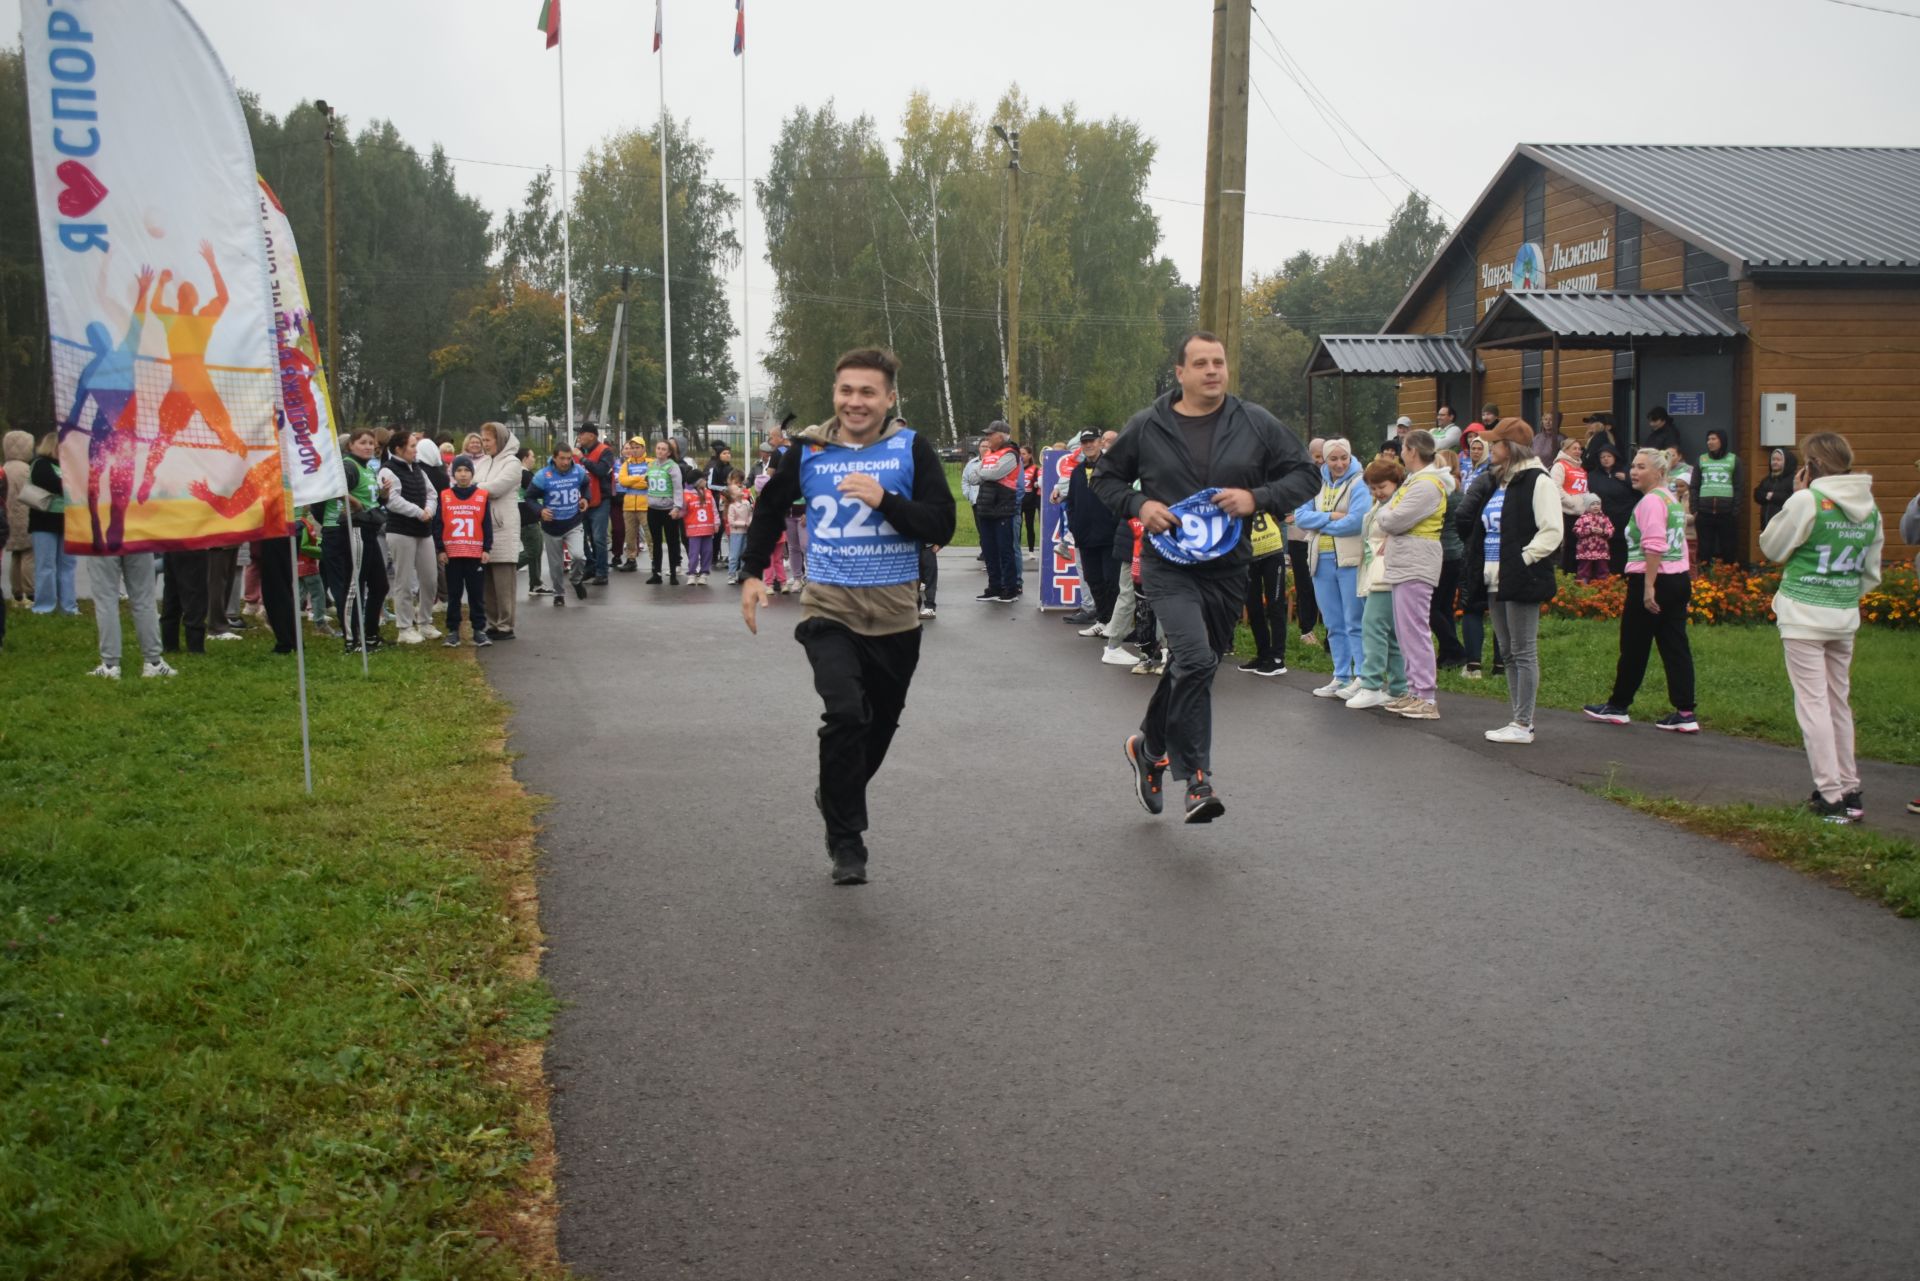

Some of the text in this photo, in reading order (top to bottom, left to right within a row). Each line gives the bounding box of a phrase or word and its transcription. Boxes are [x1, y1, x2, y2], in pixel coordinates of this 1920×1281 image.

[48, 0, 99, 157] СПОР
[1549, 227, 1609, 272] Лыжный
[814, 458, 900, 475] ТУКАЕВСКИЙ
[549, 488, 579, 505] 218
[696, 508, 708, 522] 8
[450, 518, 474, 537] 21
